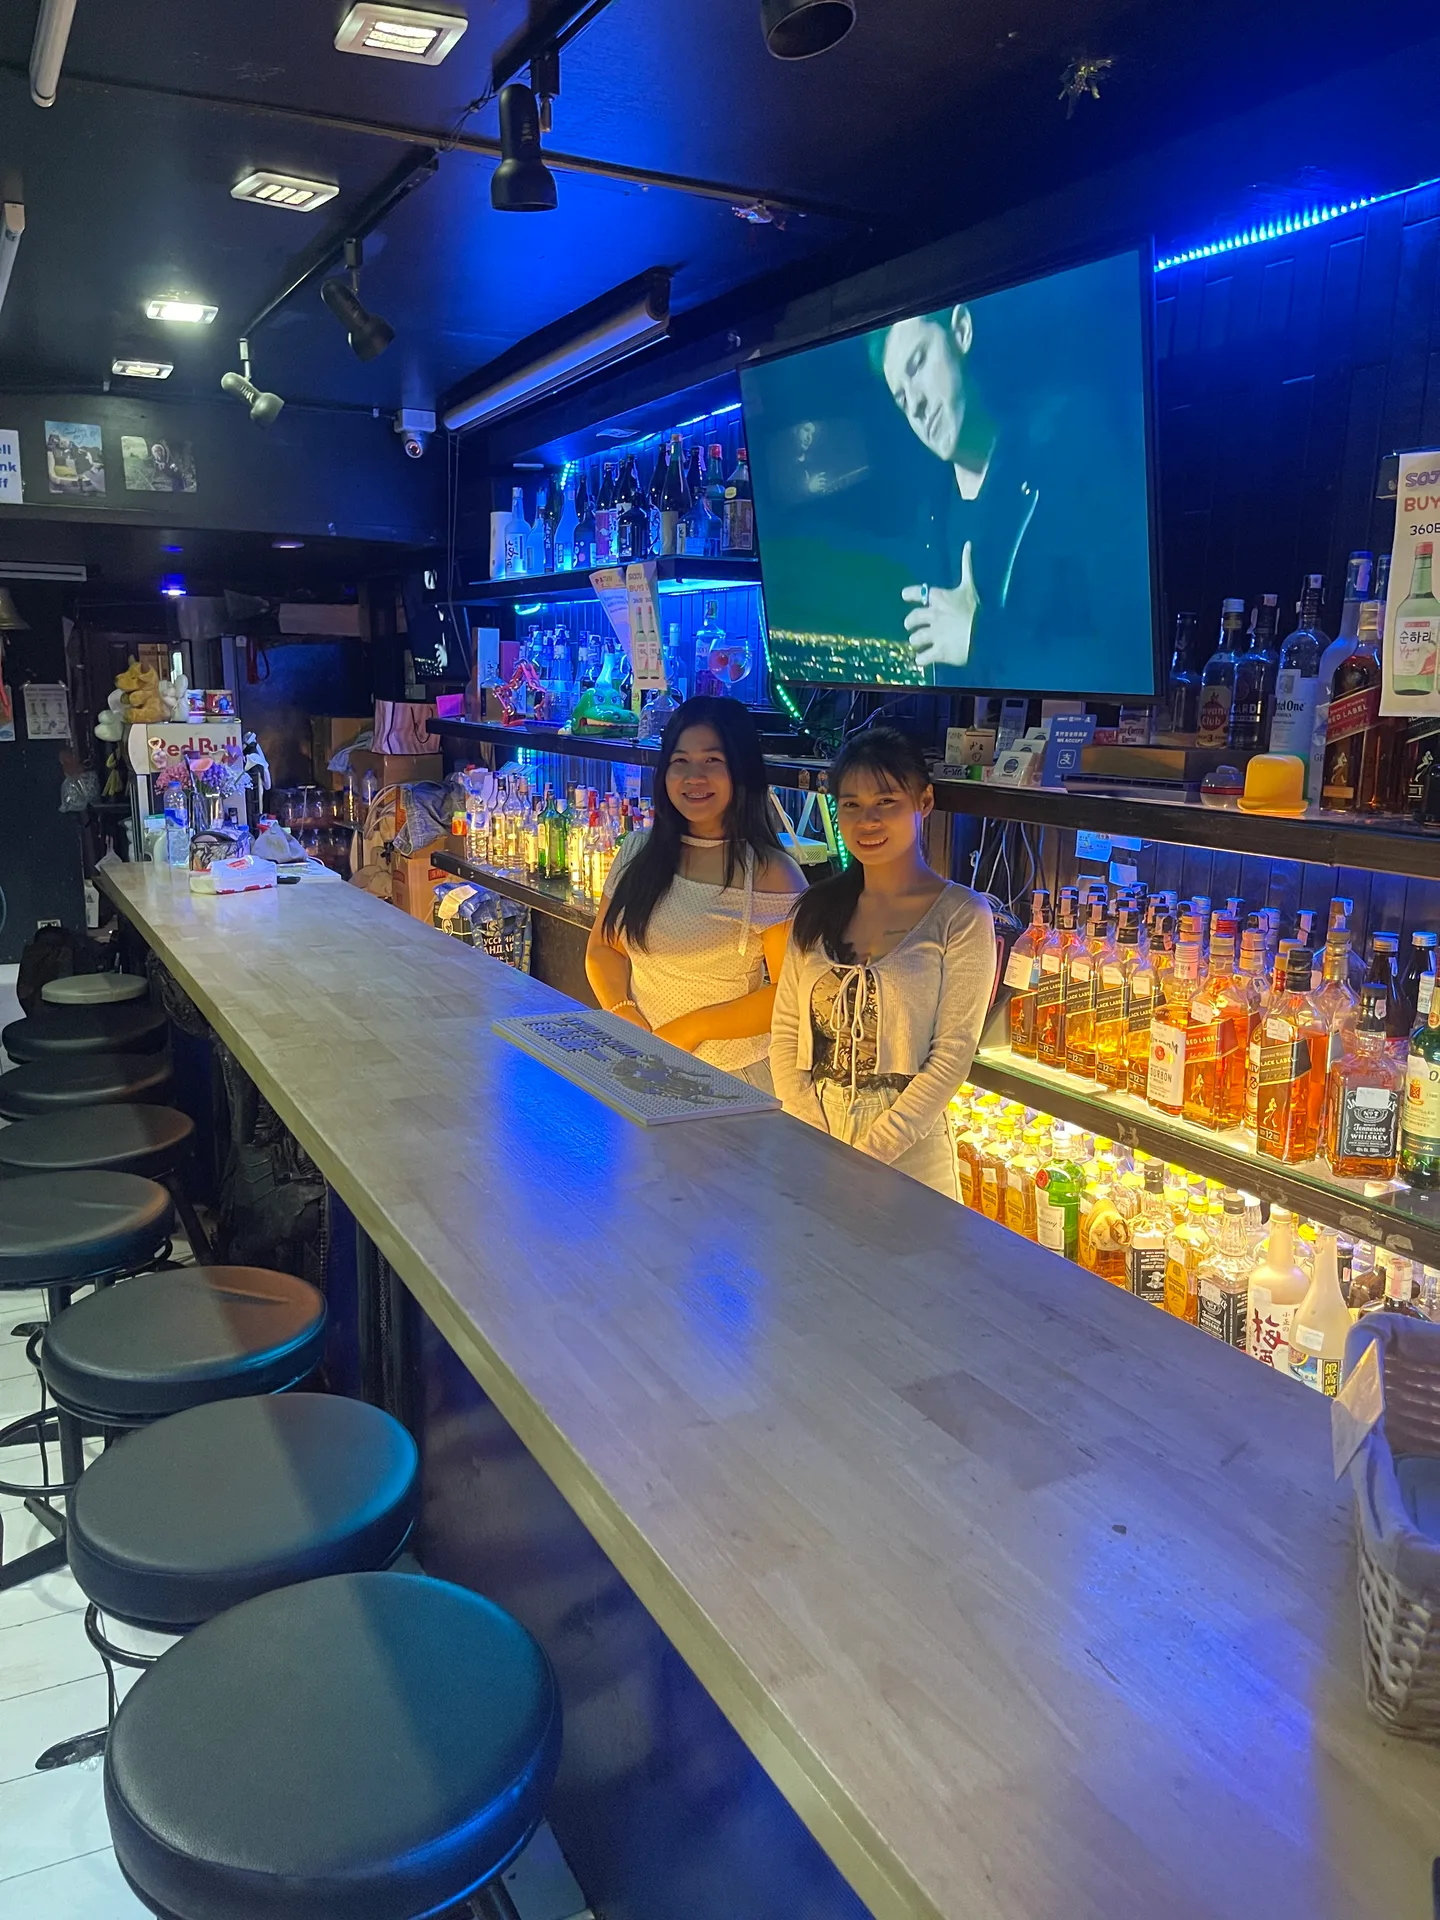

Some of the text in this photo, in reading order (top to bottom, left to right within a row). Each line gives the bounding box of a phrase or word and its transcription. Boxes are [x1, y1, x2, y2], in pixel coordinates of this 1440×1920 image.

[1404, 496, 1440, 512] BUY
[1400, 631, 1432, 644] 순하리
[1287, 700, 1304, 711] One
[1342, 704, 1368, 717] LABEL
[1202, 716, 1221, 726] Club
[1198, 1035, 1220, 1044] LABEL
[1072, 1054, 1079, 1062] 12
[1103, 1064, 1109, 1072] 12
[1133, 1074, 1140, 1082] 12
[1353, 1123, 1386, 1132] Tennessee
[1265, 1131, 1273, 1139] 12
[1350, 1133, 1388, 1141] WHISKEY
[1281, 1312, 1290, 1332] 小正の
[1252, 1308, 1289, 1368] 梅酒
